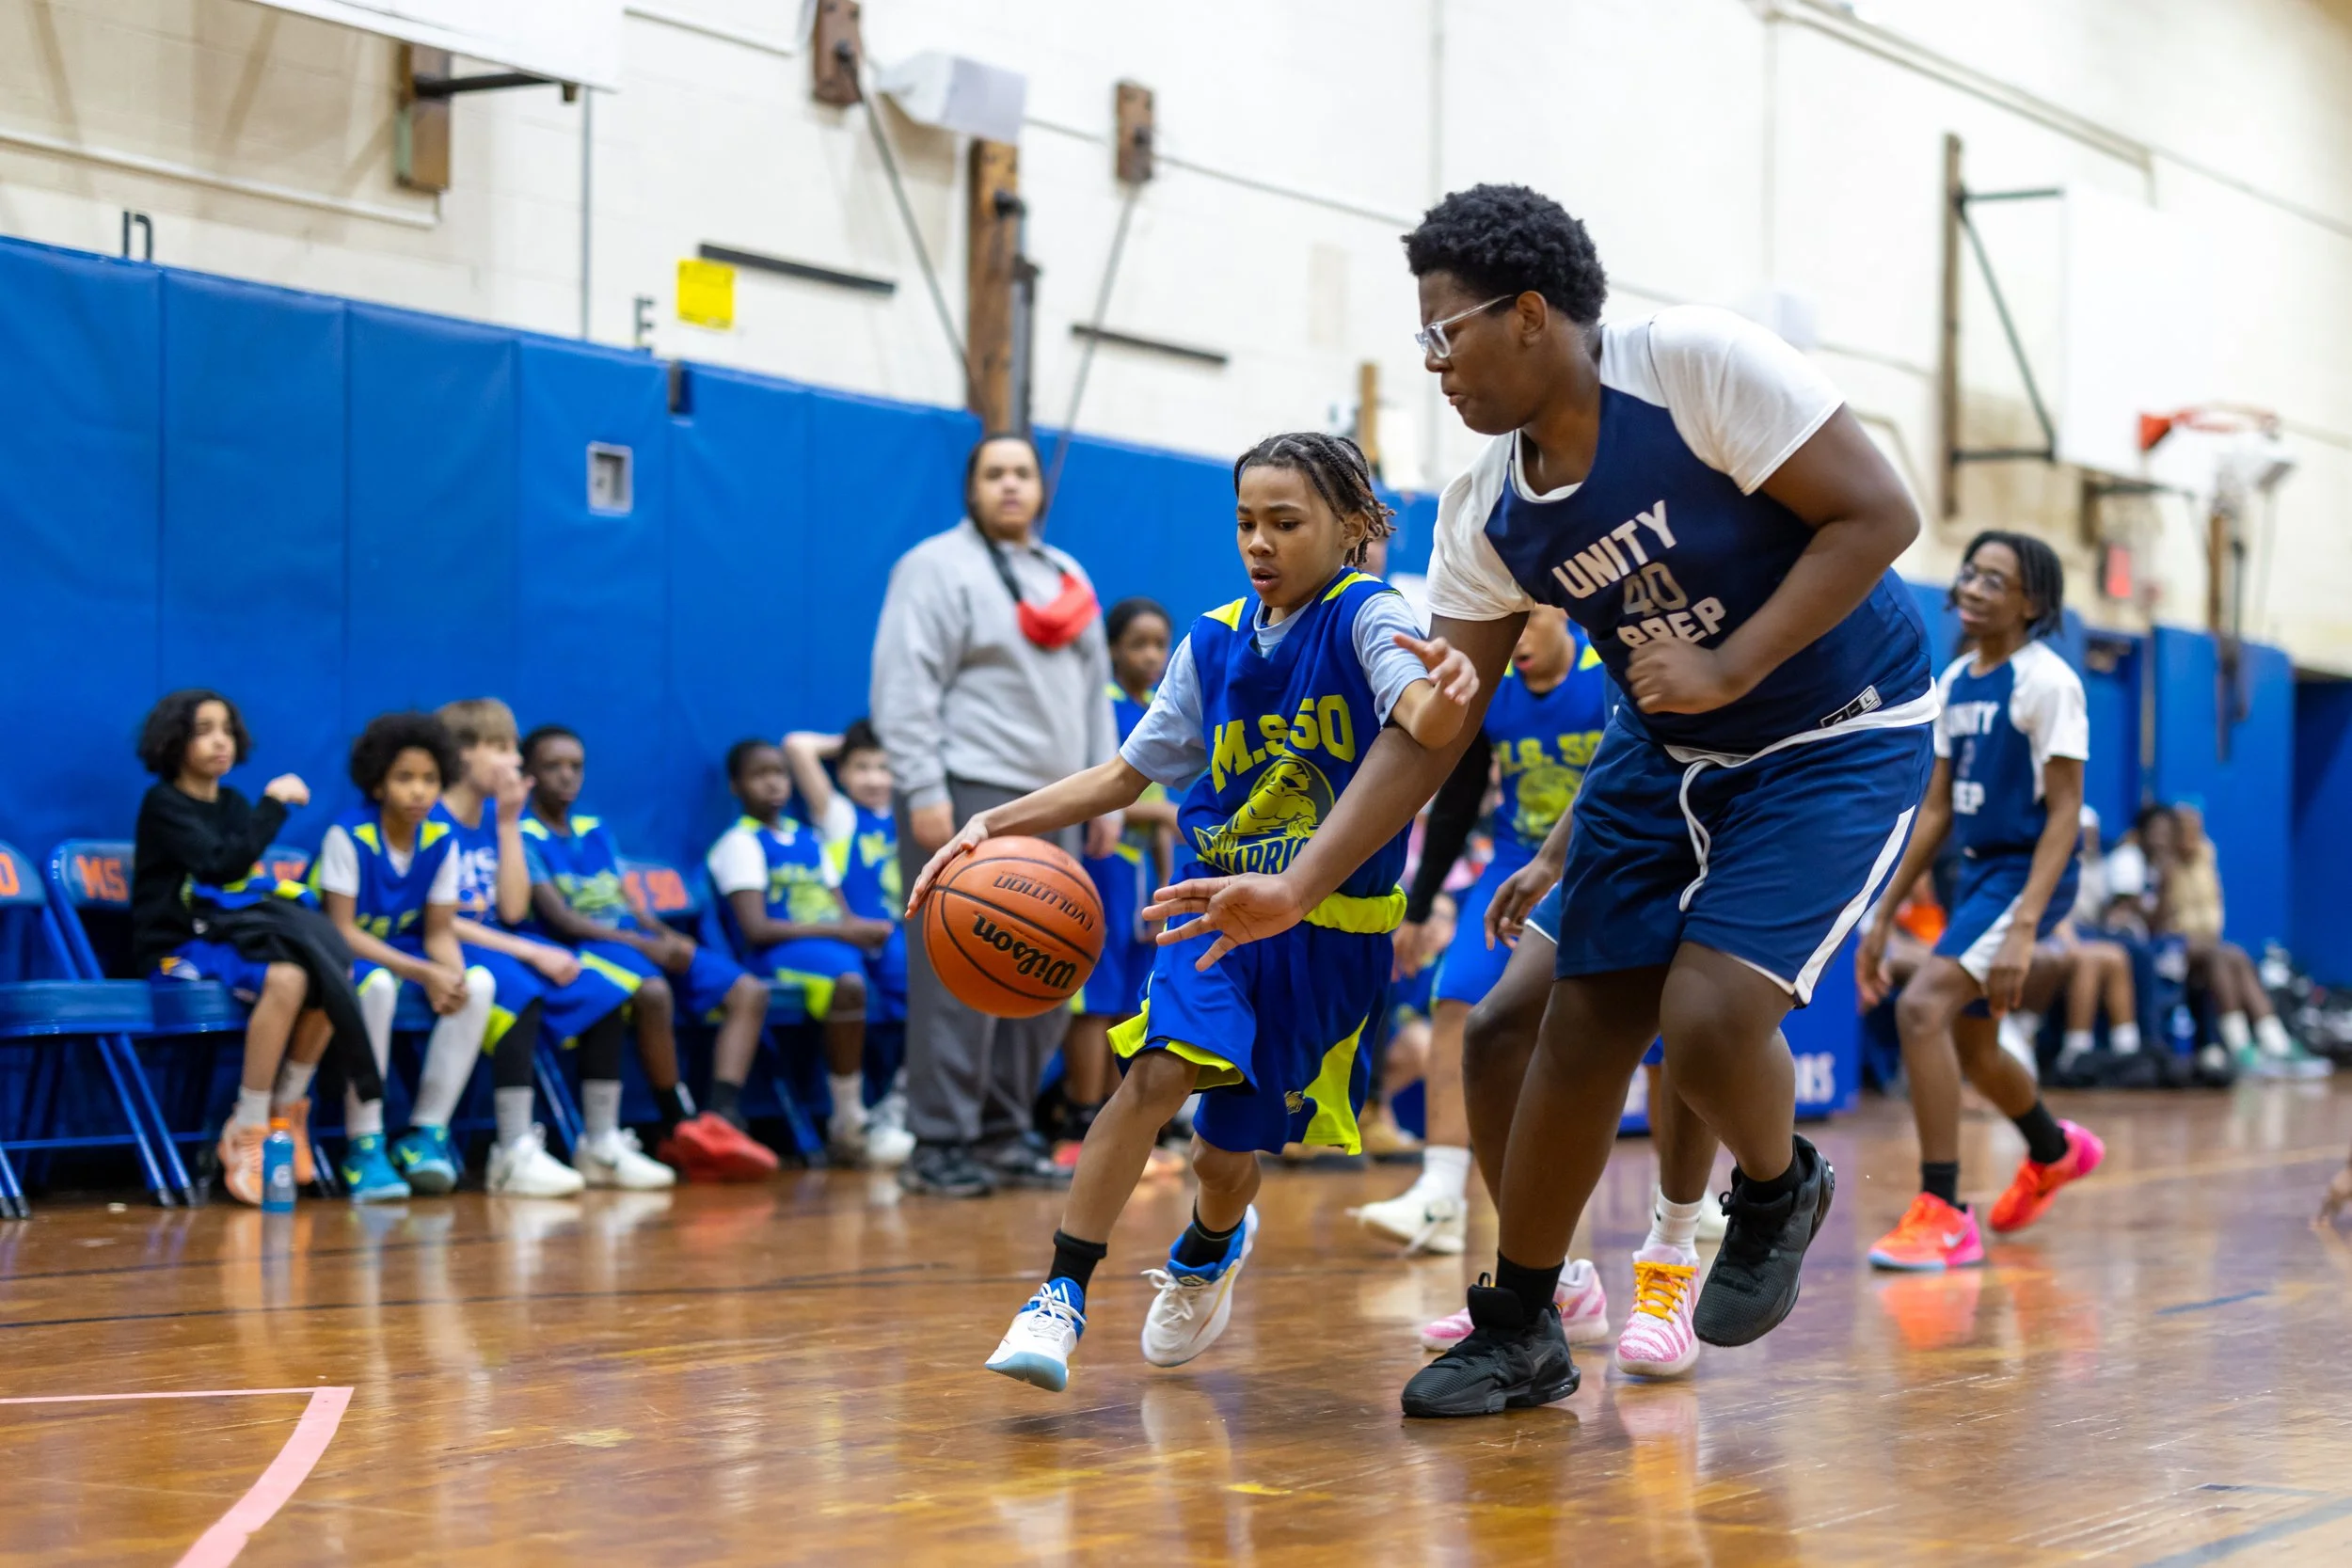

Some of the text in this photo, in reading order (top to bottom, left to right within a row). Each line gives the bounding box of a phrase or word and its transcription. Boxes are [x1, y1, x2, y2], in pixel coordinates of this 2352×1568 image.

[1551, 499, 1677, 599] UNITY
[1622, 562, 1689, 618] 40
[76, 854, 129, 901] MS
[972, 912, 1078, 990] Wilson
